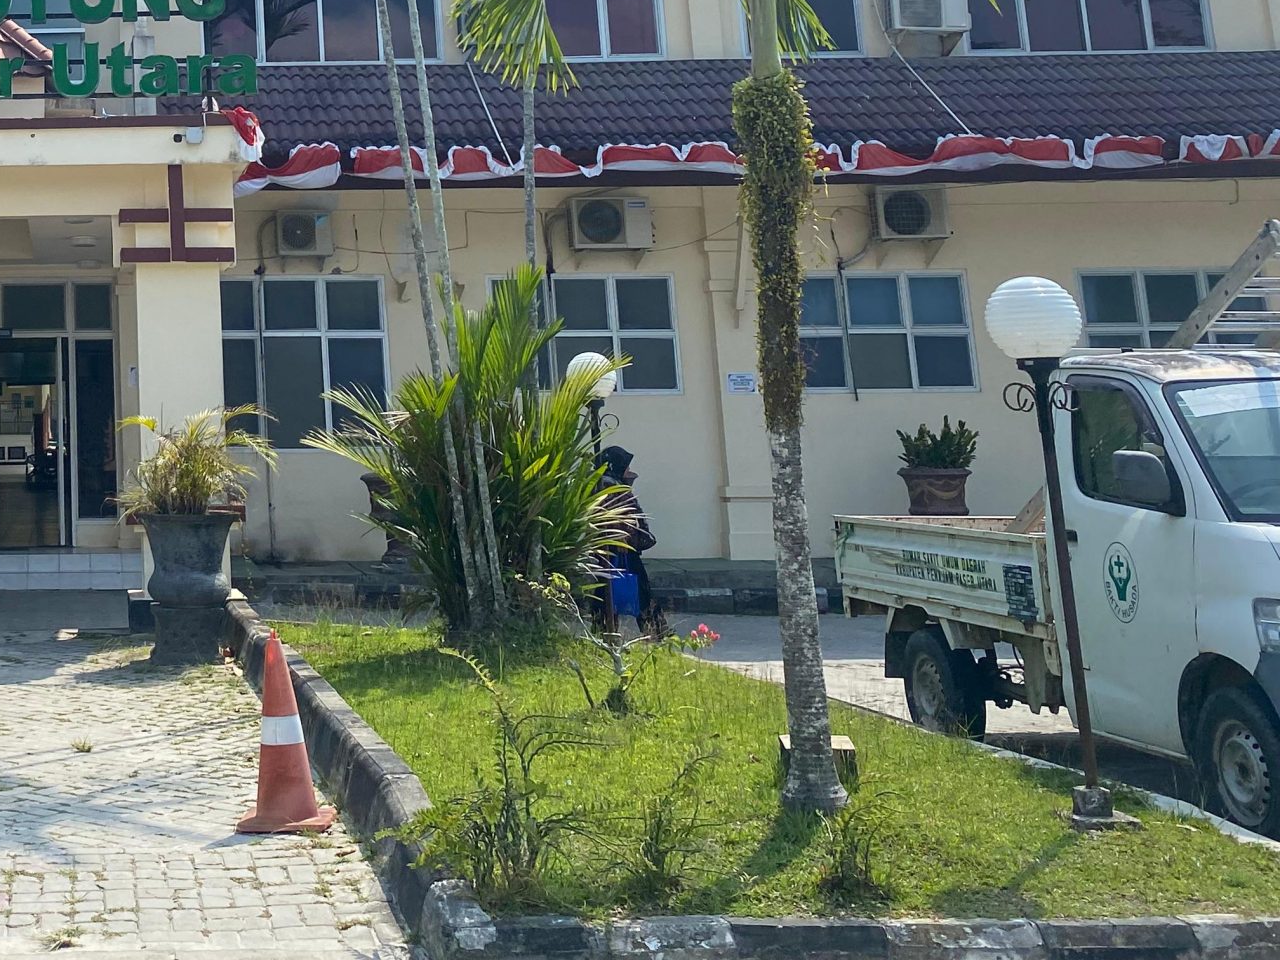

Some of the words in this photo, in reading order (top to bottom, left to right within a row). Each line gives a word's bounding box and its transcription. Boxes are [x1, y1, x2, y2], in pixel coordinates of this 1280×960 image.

[51, 42, 258, 99] Utara
[895, 563, 926, 580] KABUPATEN
[955, 572, 975, 588] PASER
[976, 577, 998, 593] UTARA
[922, 552, 939, 567] SAKIT
[940, 554, 959, 570] UMUM
[961, 557, 987, 574] DAERAH
[1104, 580, 1121, 615] BAKTI
[1121, 584, 1138, 618] HUSADA
